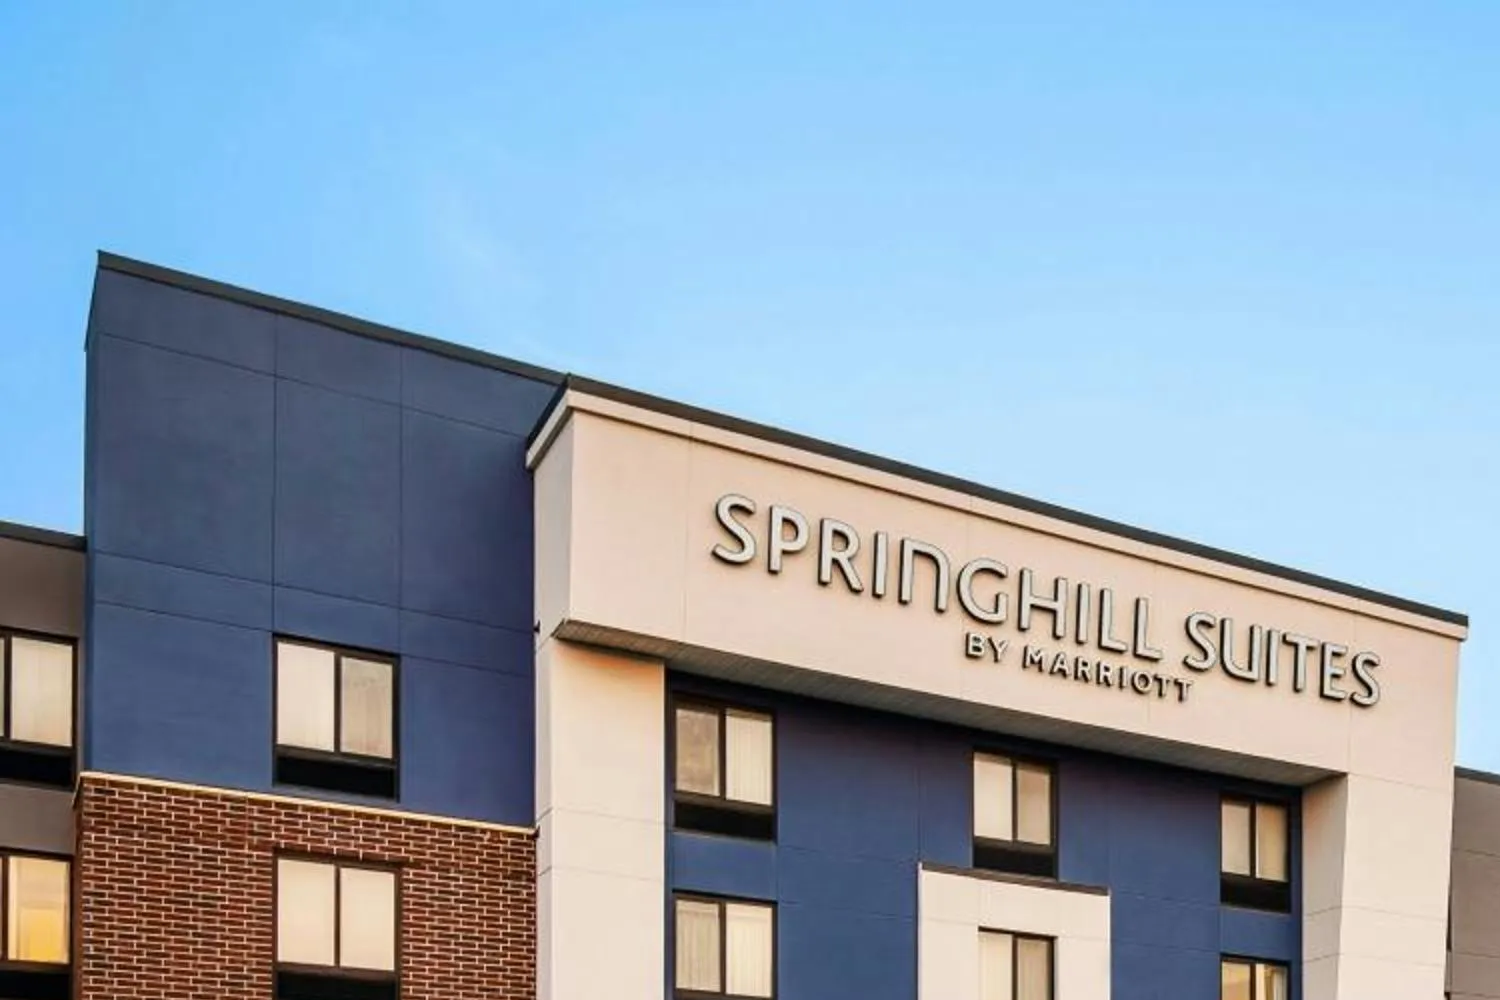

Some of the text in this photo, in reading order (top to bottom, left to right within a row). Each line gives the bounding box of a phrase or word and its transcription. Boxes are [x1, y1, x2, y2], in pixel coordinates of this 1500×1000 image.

[712, 493, 1382, 707] SPRINGHILL SUITES
[965, 632, 1194, 703] BY MARRIOTT
